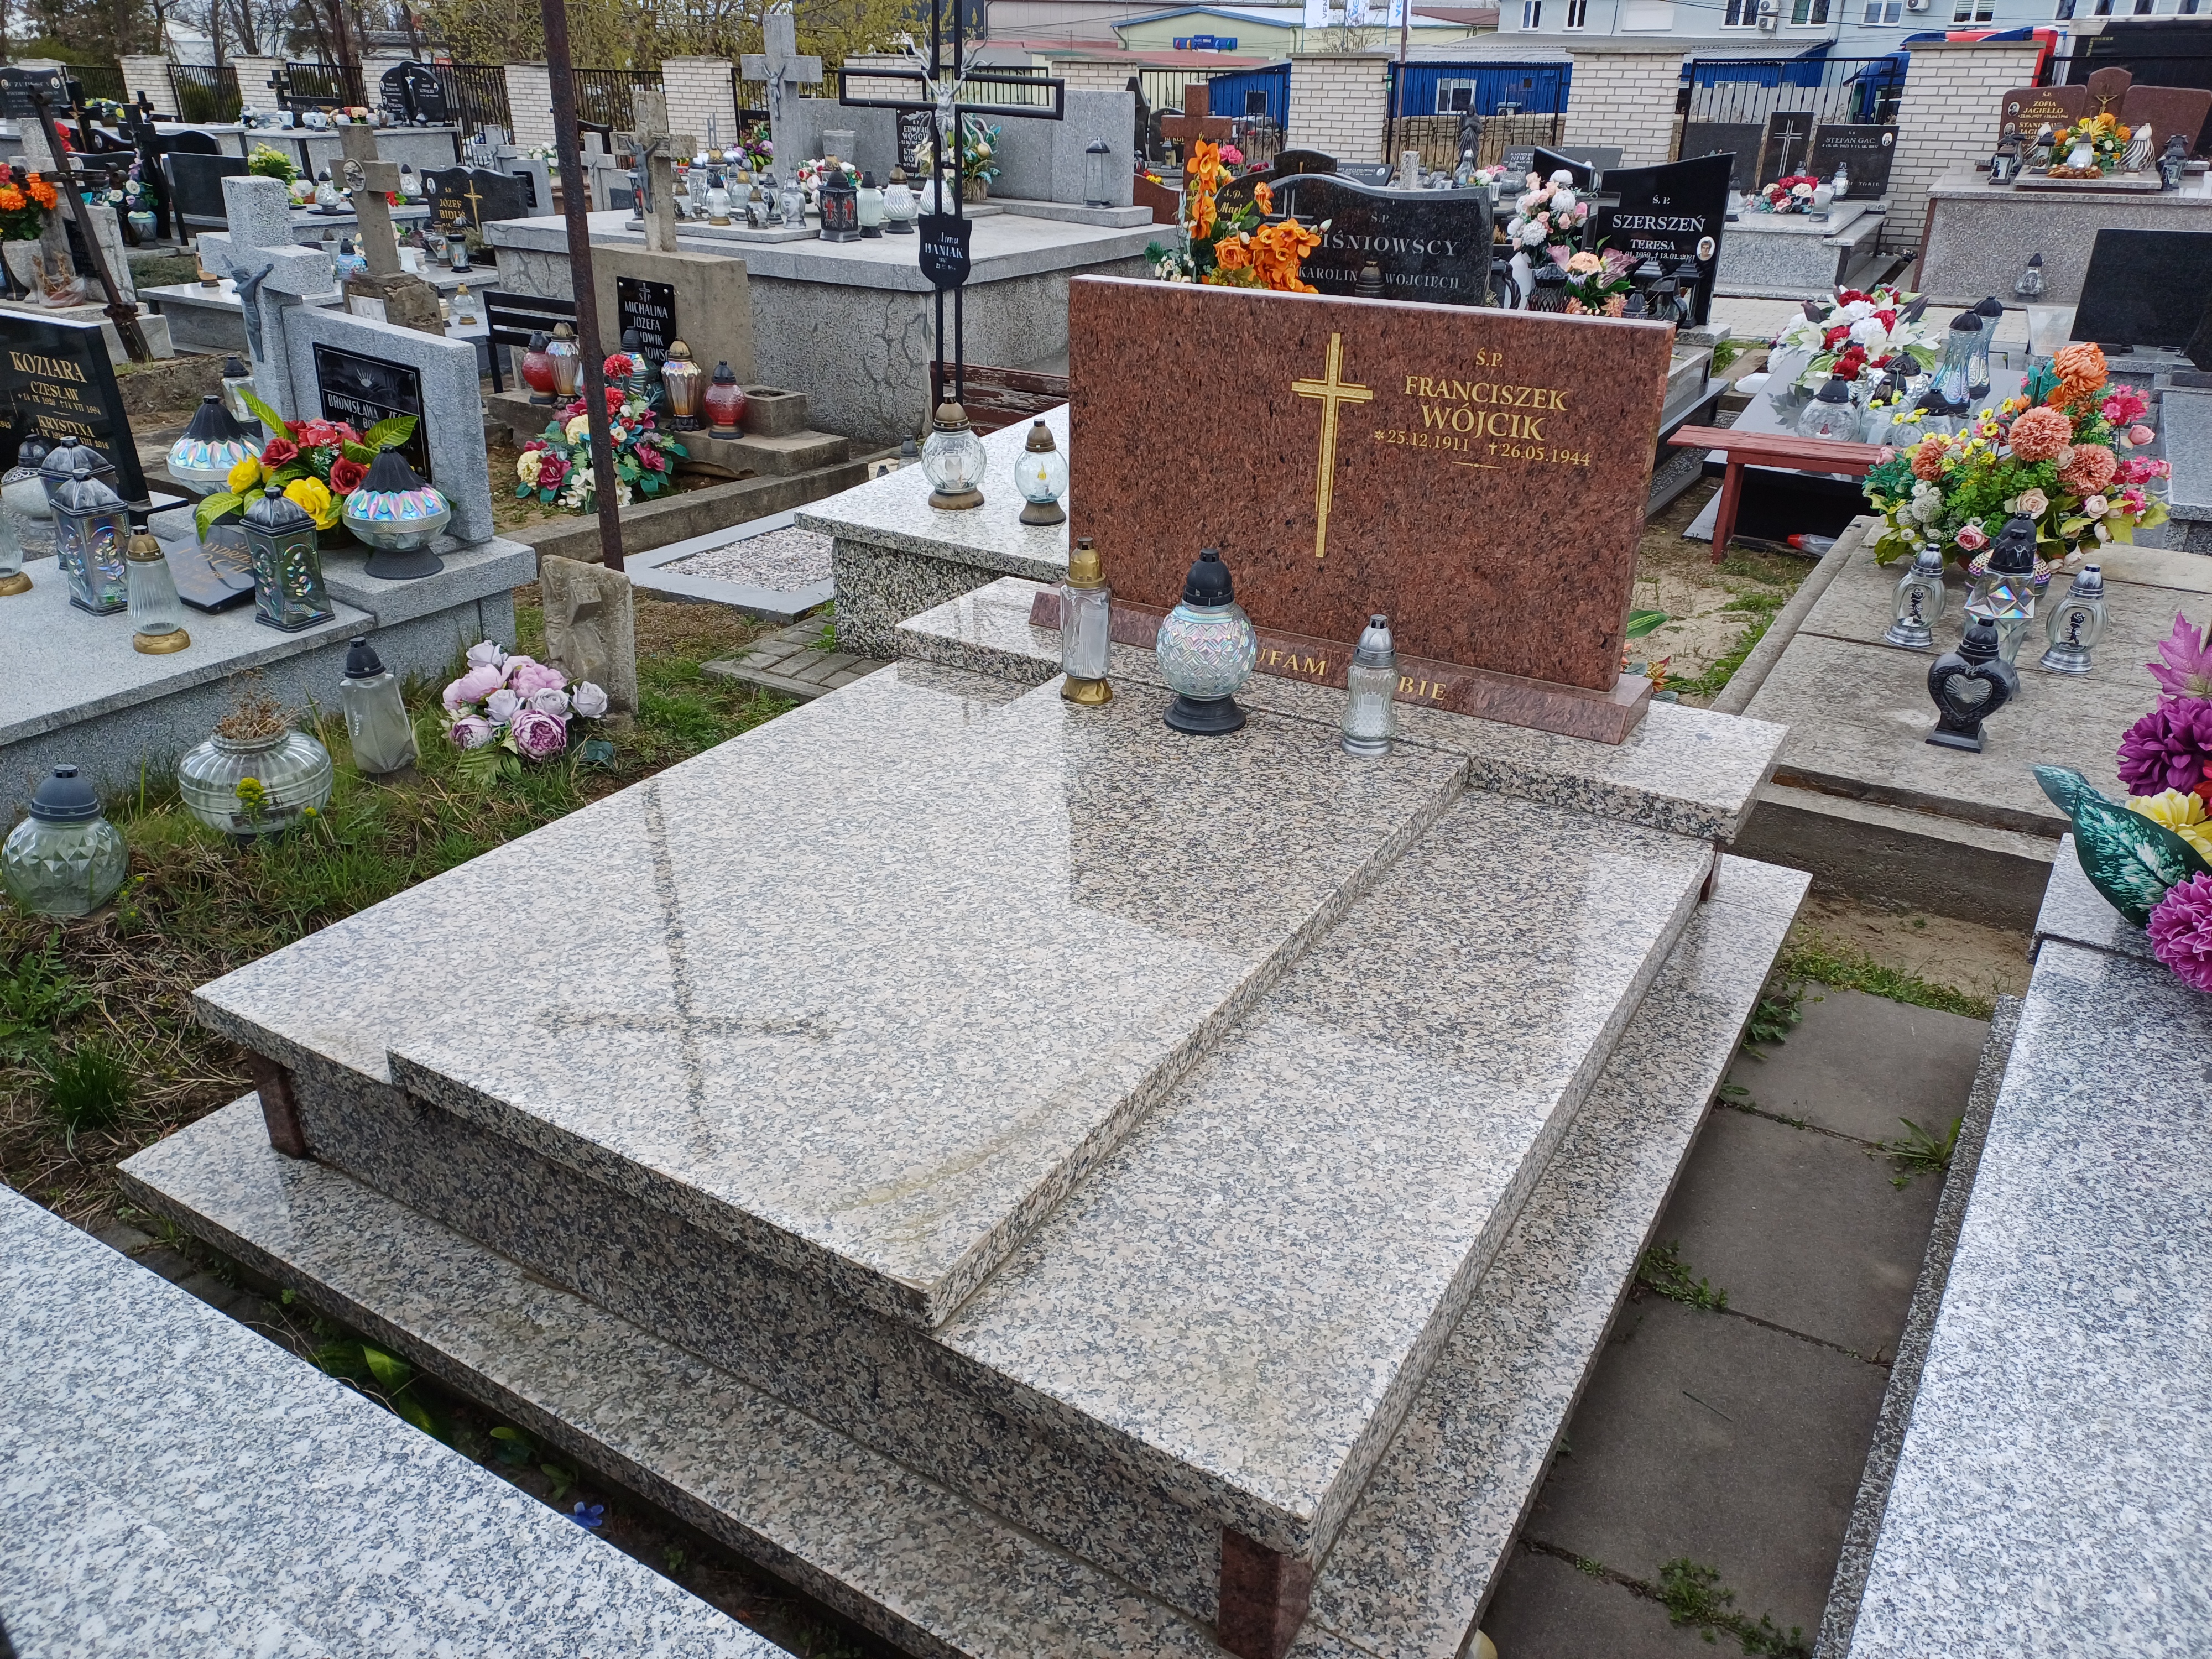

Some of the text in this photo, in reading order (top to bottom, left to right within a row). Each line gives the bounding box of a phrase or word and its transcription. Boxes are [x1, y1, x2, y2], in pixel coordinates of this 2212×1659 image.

[439, 197, 462, 208] JÓZEF
[1612, 214, 1706, 232] SZERSZEŃ
[1322, 229, 1460, 256] IŚNIOWSCY
[1630, 238, 1676, 251] TERESA
[1300, 266, 1460, 289] KAROLIN WOJCIECH
[624, 300, 669, 319] MICHALINA
[640, 331, 664, 346] DWIK
[9, 351, 88, 383] KOZIARA
[1475, 347, 1503, 368] Ś.P.
[1403, 375, 1569, 411] FRANCISZEK
[327, 393, 379, 420] BRONISŁAWA
[36, 414, 96, 437] KRYSTYNA
[1421, 402, 1546, 441] WÓJCIK
[1386, 429, 1591, 467] 25.12.1911 26.05.1944
[1398, 675, 1447, 701] BIE
